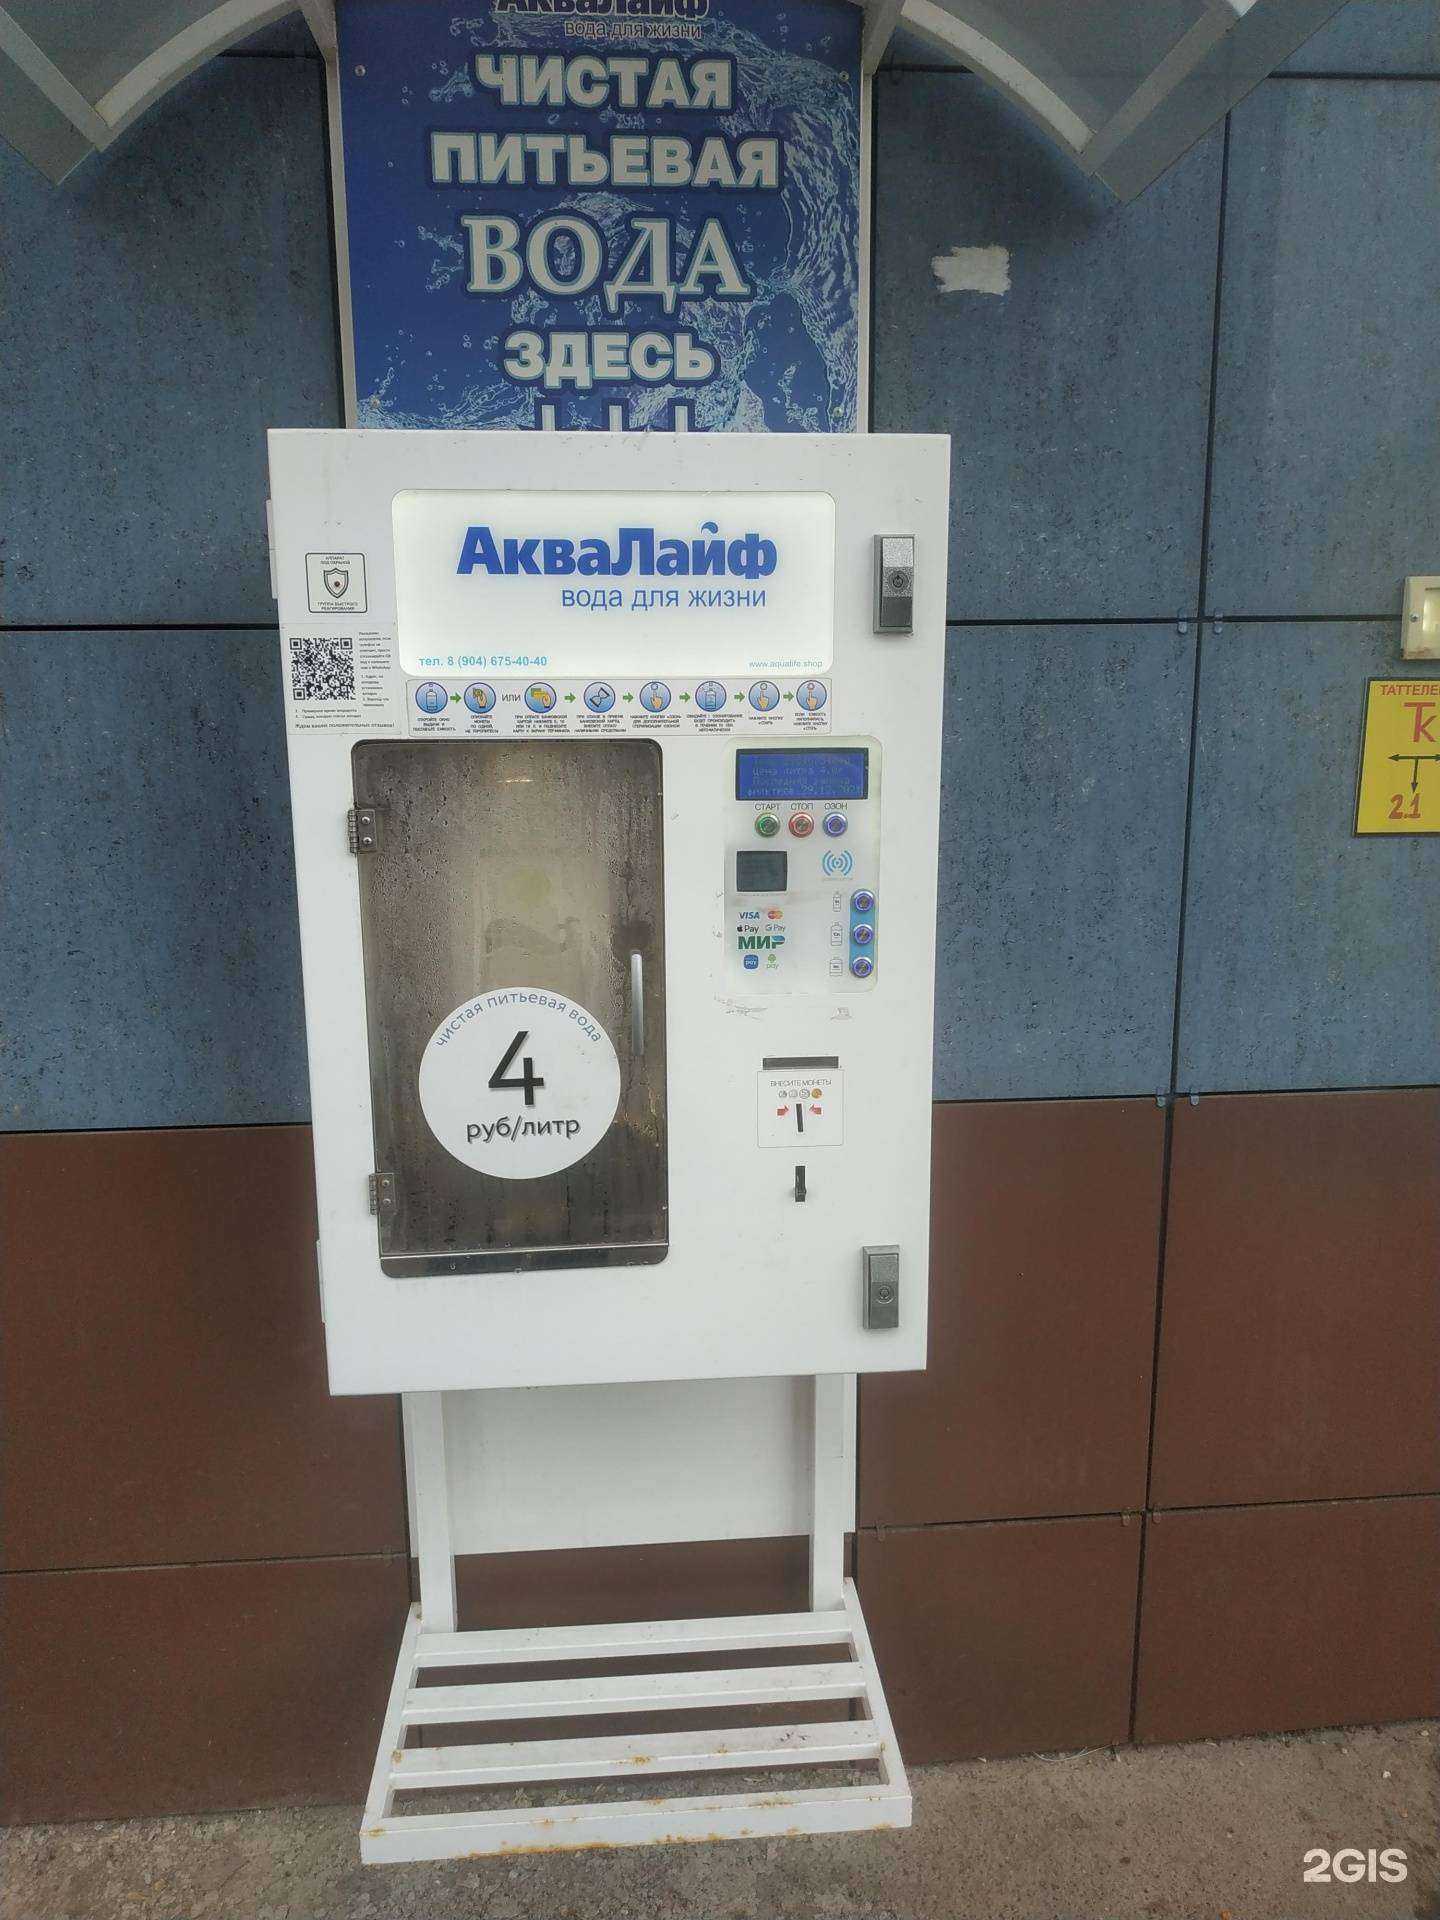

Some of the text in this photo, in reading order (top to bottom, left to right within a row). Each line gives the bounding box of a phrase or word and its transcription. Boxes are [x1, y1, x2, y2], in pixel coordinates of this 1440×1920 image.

[565, 21, 701, 39] вода для жизни
[476, 54, 732, 108] ЧИСТАЯ
[431, 132, 780, 188] ПИТЬЕВАЯ
[461, 213, 752, 313] ВОДА
[504, 331, 716, 390] ЗДЕСЬ
[456, 521, 778, 579] АкваЛайф
[561, 589, 767, 611] вода для жизни
[419, 656, 548, 668] тел. 8 (904) 675-40-40
[749, 659, 823, 669] www.aqualife.shop
[1380, 684, 1440, 696] ТАТТЕЛЕ
[502, 694, 521, 702] ИЛИ
[755, 802, 780, 811] СТАРТ
[790, 802, 814, 810] СТОП
[824, 802, 848, 810] ОЗОН
[739, 911, 761, 920] VISA
[744, 924, 760, 934] Pay
[738, 935, 786, 949] МИР
[435, 992, 602, 1047] чистая питьевая вода
[488, 1030, 545, 1106] 4
[770, 1078, 832, 1087] ВНЕСИТЕ МОНЕТЫ
[466, 1115, 580, 1144] руб/литр
